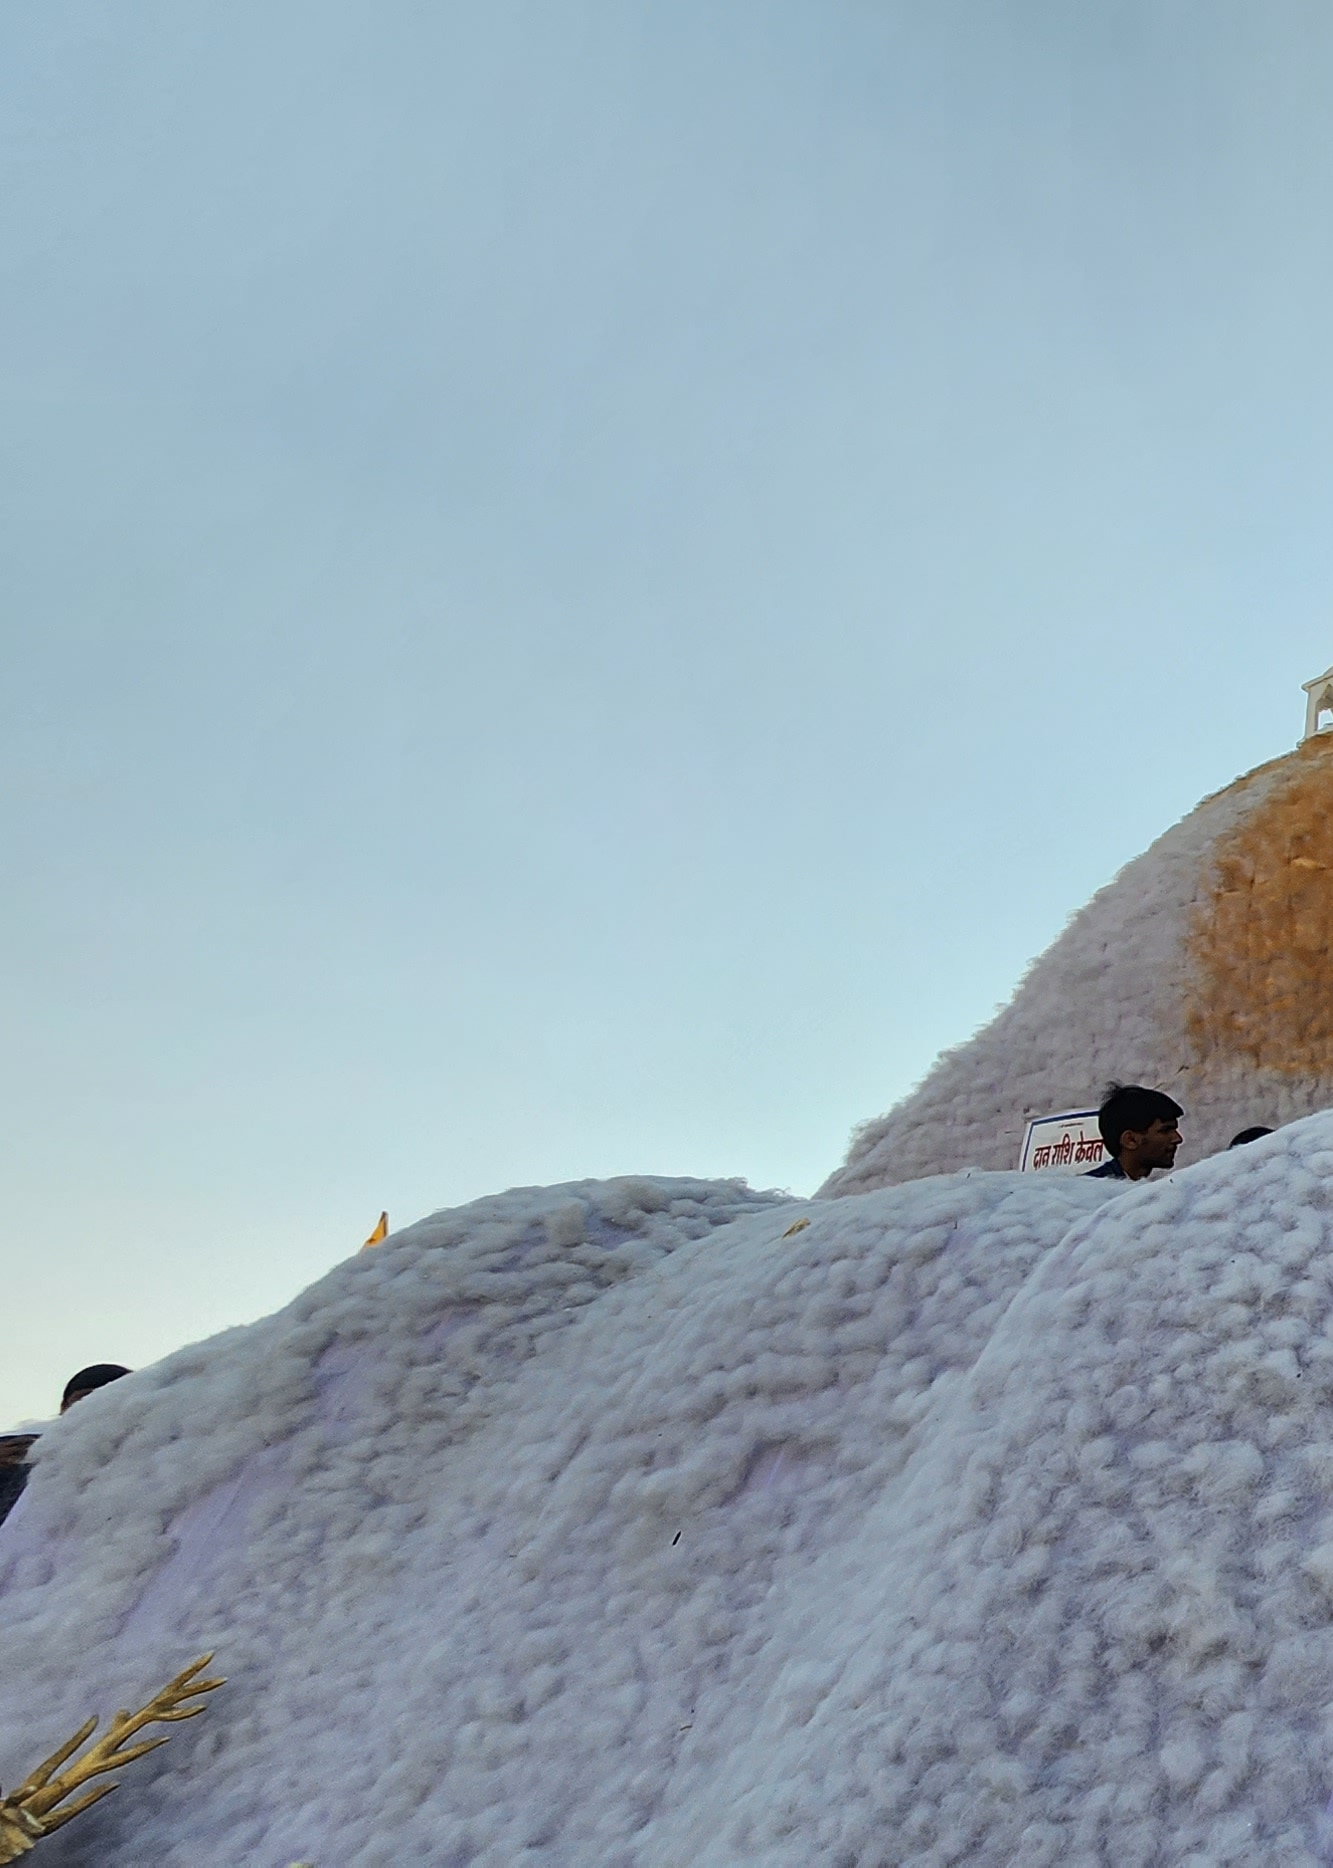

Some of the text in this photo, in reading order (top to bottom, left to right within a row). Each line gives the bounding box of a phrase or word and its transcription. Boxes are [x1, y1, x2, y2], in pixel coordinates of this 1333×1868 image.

[1033, 1130, 1104, 1171] दान राशि केवल
